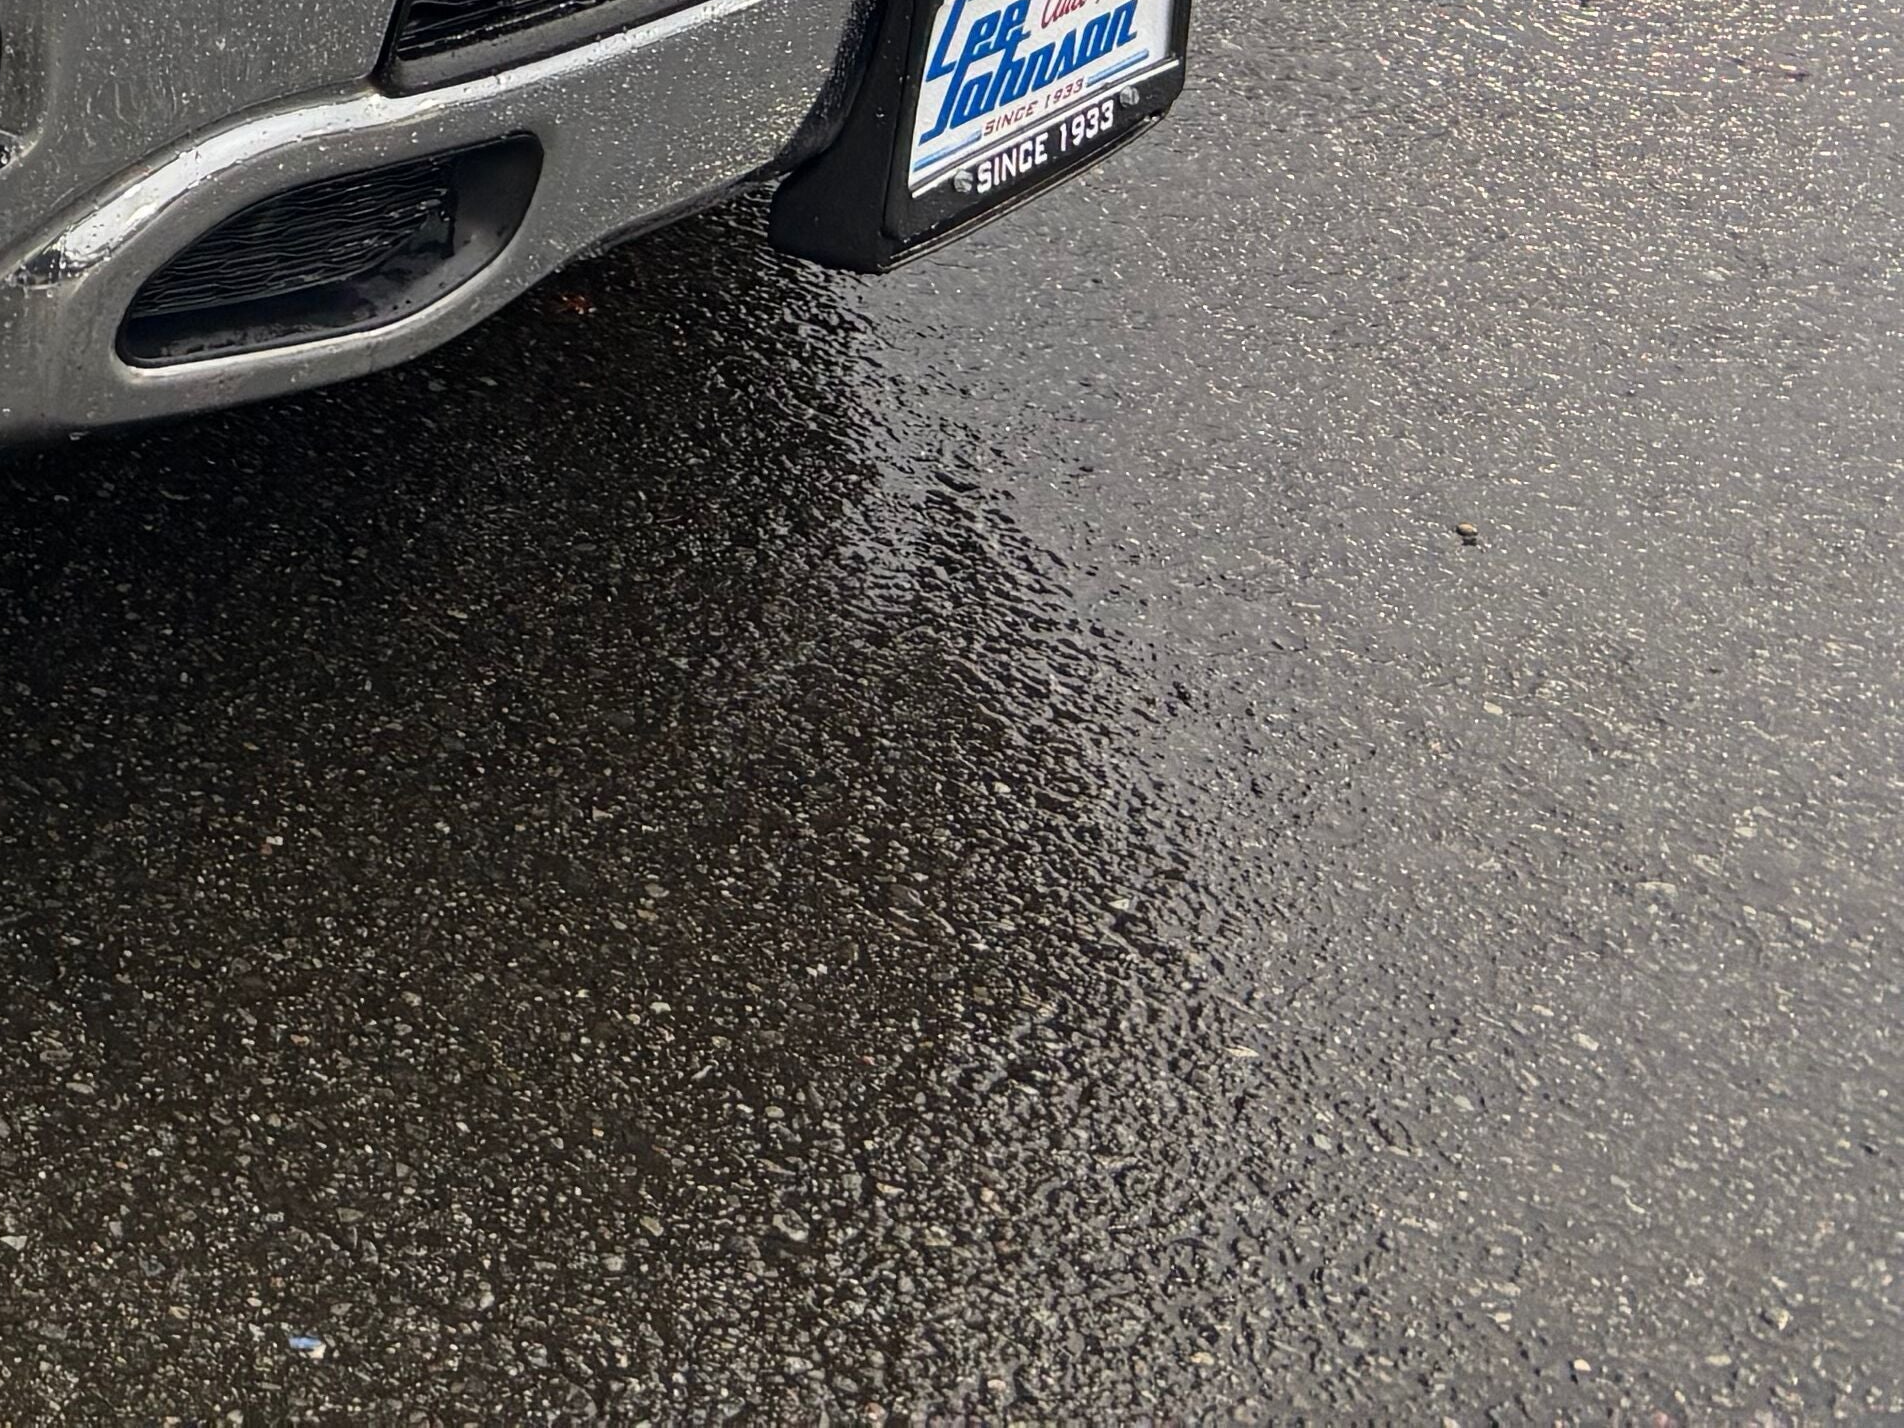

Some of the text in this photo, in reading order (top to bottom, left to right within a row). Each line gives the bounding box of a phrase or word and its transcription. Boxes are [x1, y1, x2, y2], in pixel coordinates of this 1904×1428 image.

[984, 75, 1085, 137] SINCE 1933
[976, 98, 1115, 194] SINCE 1933
